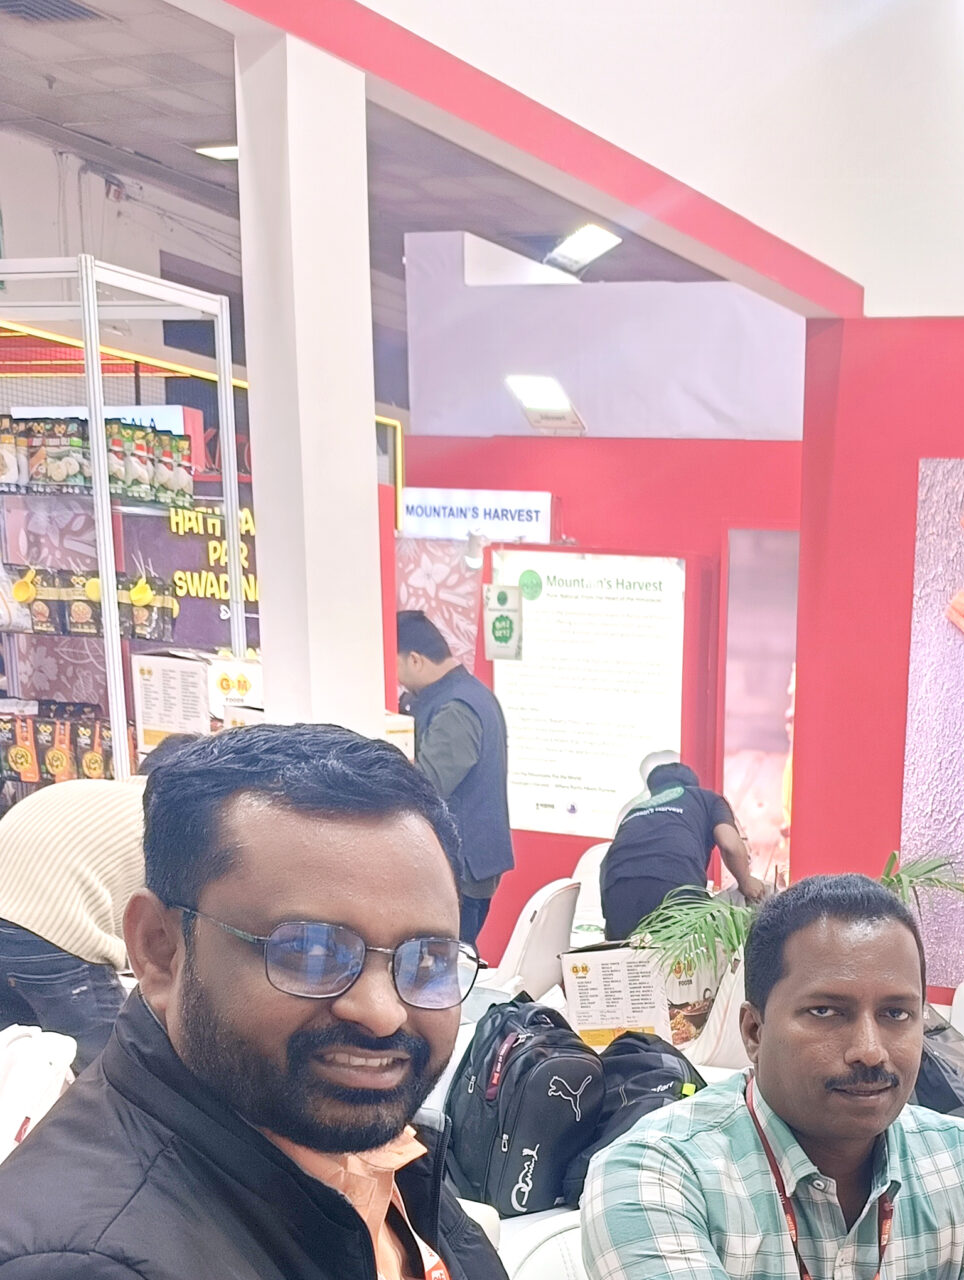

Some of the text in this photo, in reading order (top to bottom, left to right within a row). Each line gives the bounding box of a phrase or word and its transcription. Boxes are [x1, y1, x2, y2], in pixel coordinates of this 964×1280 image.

[406, 504, 541, 522] MOUNTAIN'S HARVEST
[615, 578, 663, 592] Harvest
